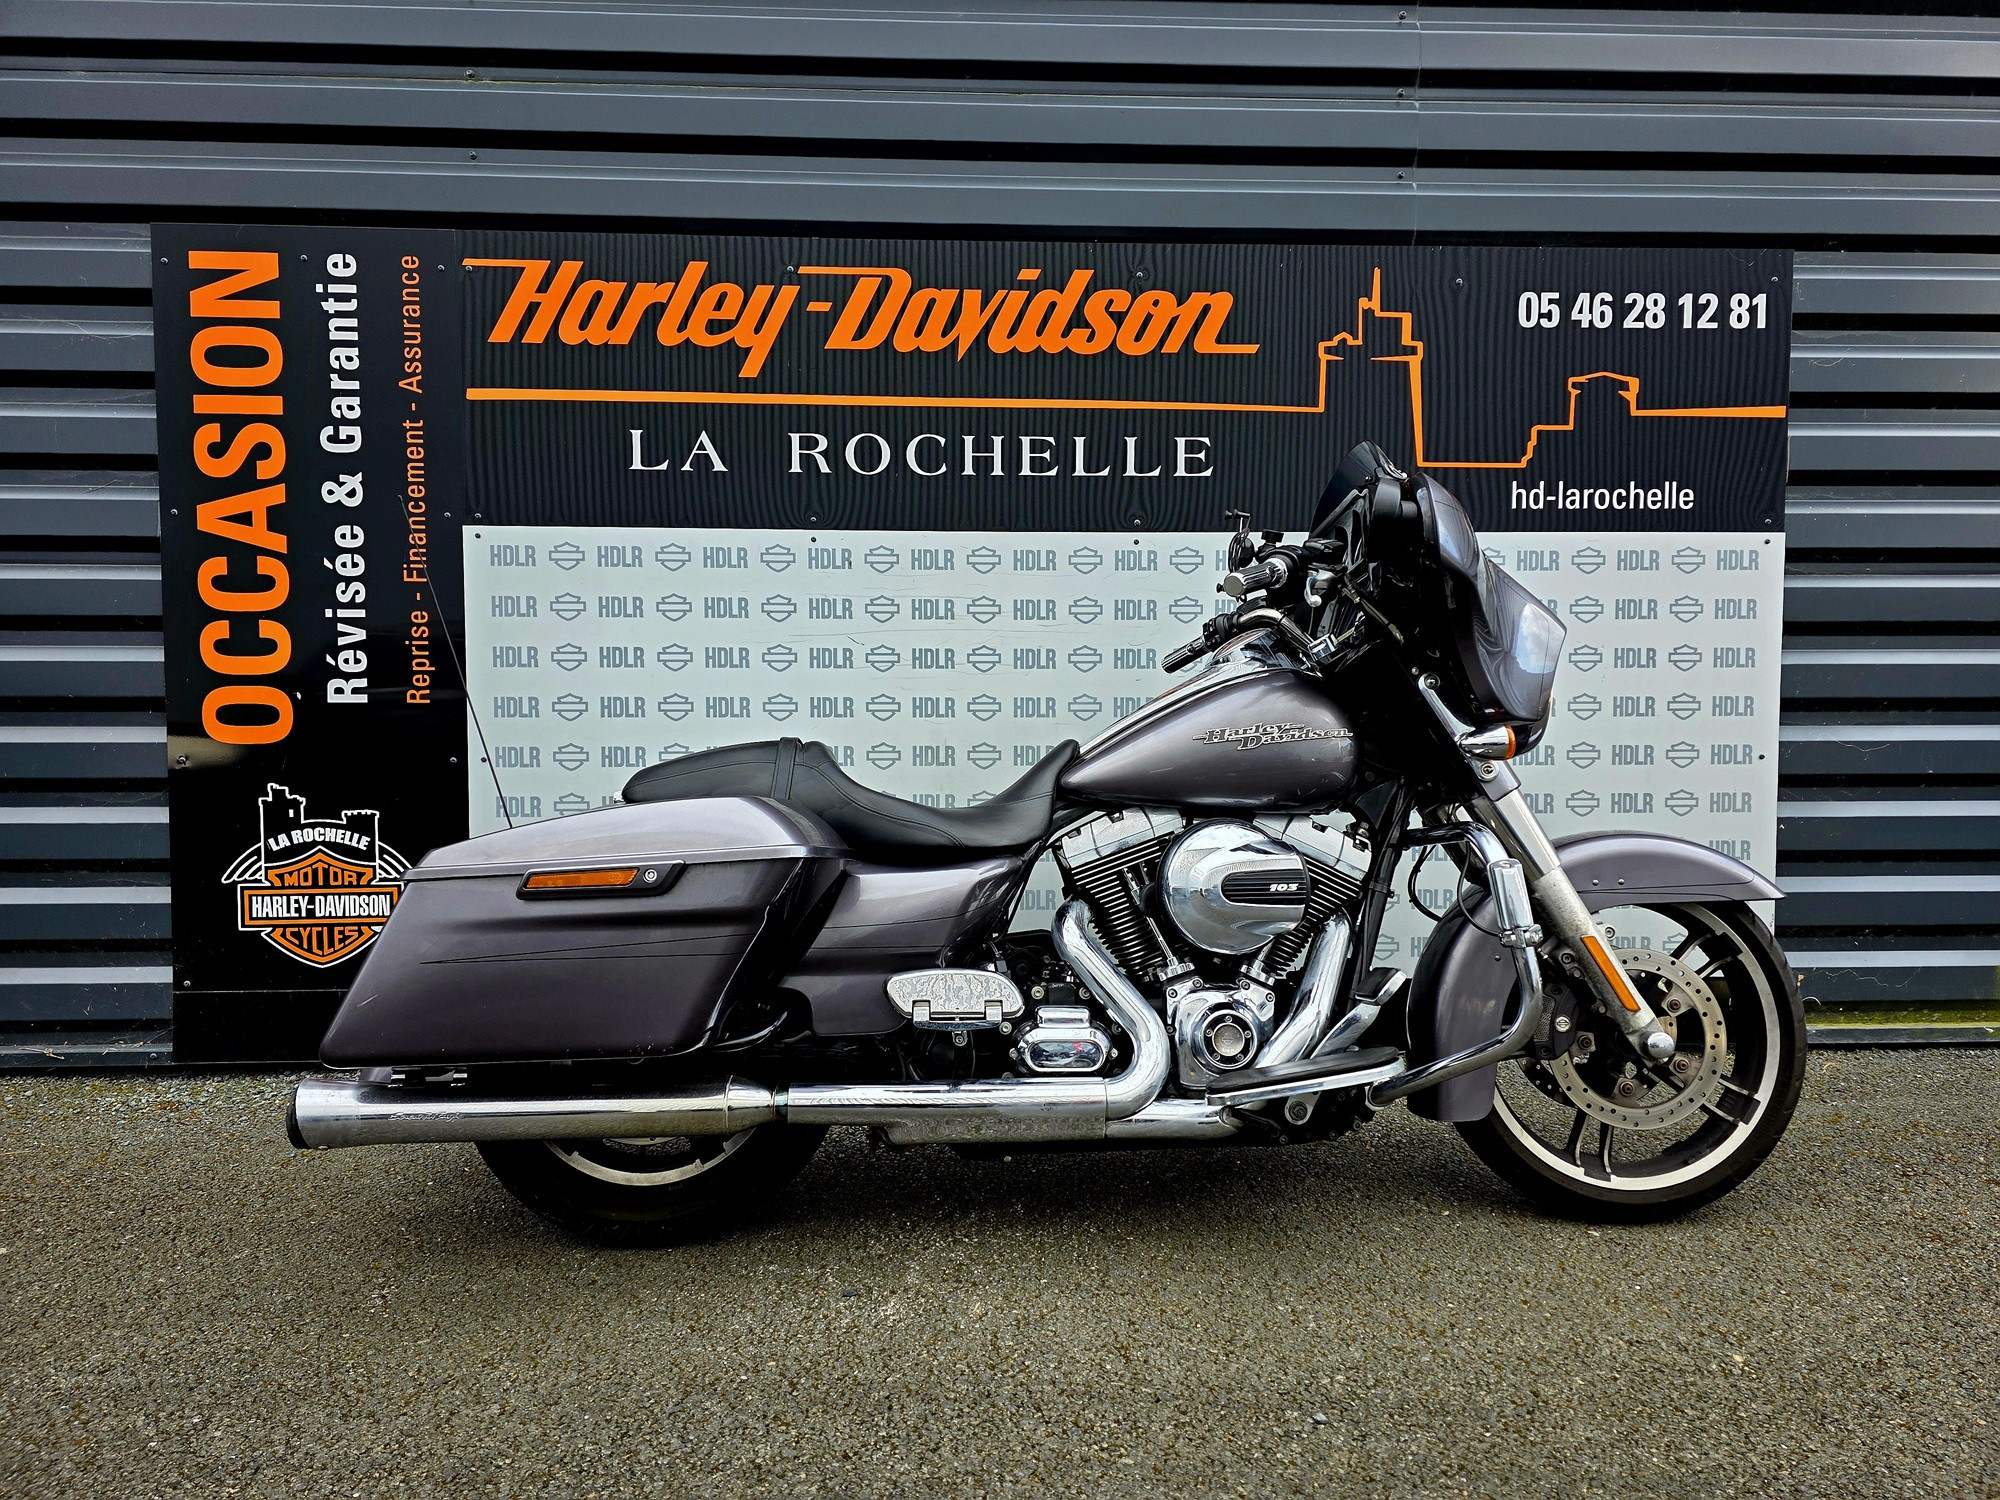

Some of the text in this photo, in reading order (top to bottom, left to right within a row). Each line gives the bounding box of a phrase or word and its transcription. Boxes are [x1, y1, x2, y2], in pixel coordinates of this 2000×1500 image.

[463, 258, 1260, 377] Harley-Davidson
[1518, 291, 1767, 329] 05 46 28 12 81
[399, 255, 422, 393] Assurance
[628, 429, 1214, 477] LA ROCHELLE
[316, 253, 368, 703] Révisée & Garantie
[188, 250, 293, 745] OCCASION
[404, 420, 427, 582] Financement
[1511, 480, 1695, 510] hd-larochelle
[489, 545, 1759, 571] HDLR HDLR HDLR HDLR HDLR HDLR HDLR HDLR HDLR HDLR
[491, 596, 538, 618] HDLR
[598, 596, 644, 618] HDLR
[704, 597, 749, 619] HDLR
[808, 598, 853, 620] HDLR
[911, 599, 955, 620] HDLR
[1013, 599, 1056, 621] HDLR
[1114, 599, 1157, 621] HDLR
[1615, 599, 1658, 620] HDLR
[1714, 599, 1757, 620] HDLR
[407, 610, 433, 704] Reprise
[492, 646, 1756, 670] HDLR HDLR HDLR HDLR HDLR HDLR HDLR HDLR HDLR
[494, 697, 540, 718] HDLR
[600, 697, 646, 719] HDLR
[706, 697, 751, 718] HDLR
[810, 697, 854, 719] HDLR
[912, 697, 955, 718] HDLR
[1014, 697, 1056, 718] HDLR
[1613, 696, 1655, 717] HDLR
[1712, 696, 1754, 717] HDLR
[495, 746, 541, 768] HDLR
[601, 746, 646, 767] HDLR
[830, 746, 854, 766] LR
[912, 745, 955, 767] HDLR
[1612, 745, 1655, 766] HDLR
[1711, 744, 1753, 765] HDLR
[496, 796, 541, 818] HDLR
[1611, 793, 1654, 814] HDLR
[1709, 793, 1752, 814] HDLR
[267, 827, 371, 851] LA ROCHELLE
[284, 861, 358, 886] MOTOR
[1269, 883, 1300, 892] 103
[251, 894, 391, 918] HARLEY-DAVIDSON
[285, 926, 359, 955] CYCLES
